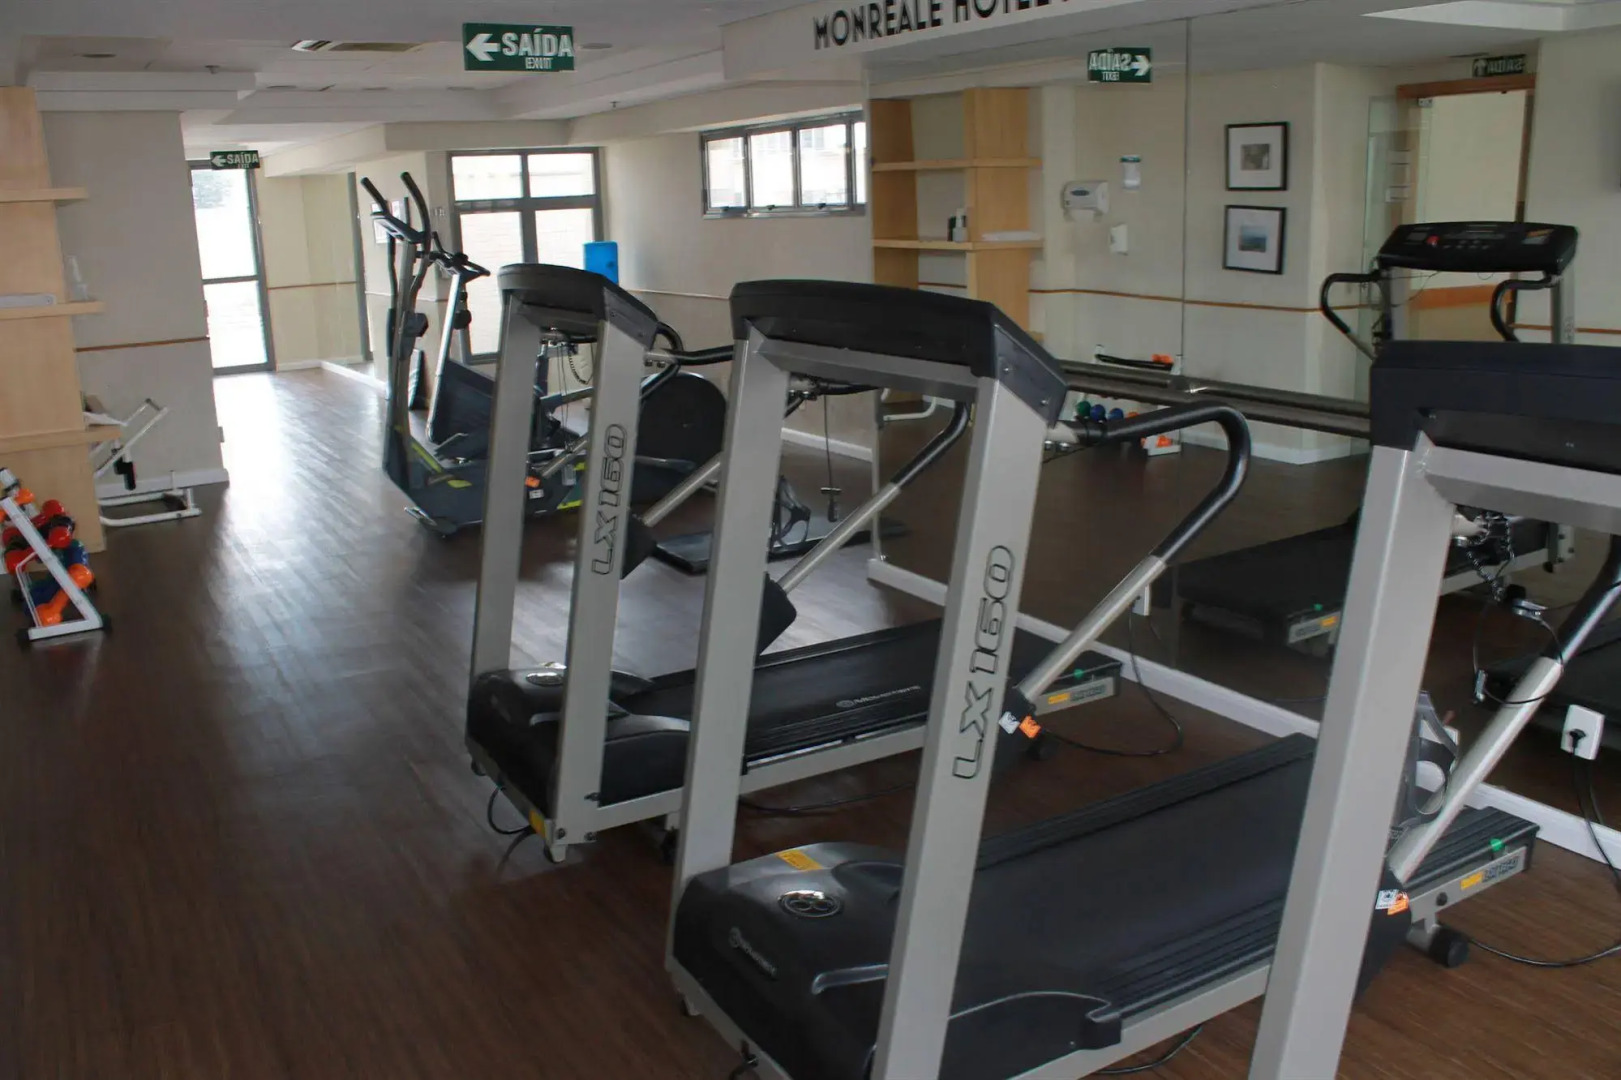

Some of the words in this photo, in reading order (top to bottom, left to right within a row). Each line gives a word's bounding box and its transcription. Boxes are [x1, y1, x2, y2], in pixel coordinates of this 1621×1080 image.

[501, 28, 575, 57] SAÍDA
[813, 0, 943, 50] MONREALE
[226, 152, 260, 165] SAÍDA
[952, 545, 1016, 780] LX160
